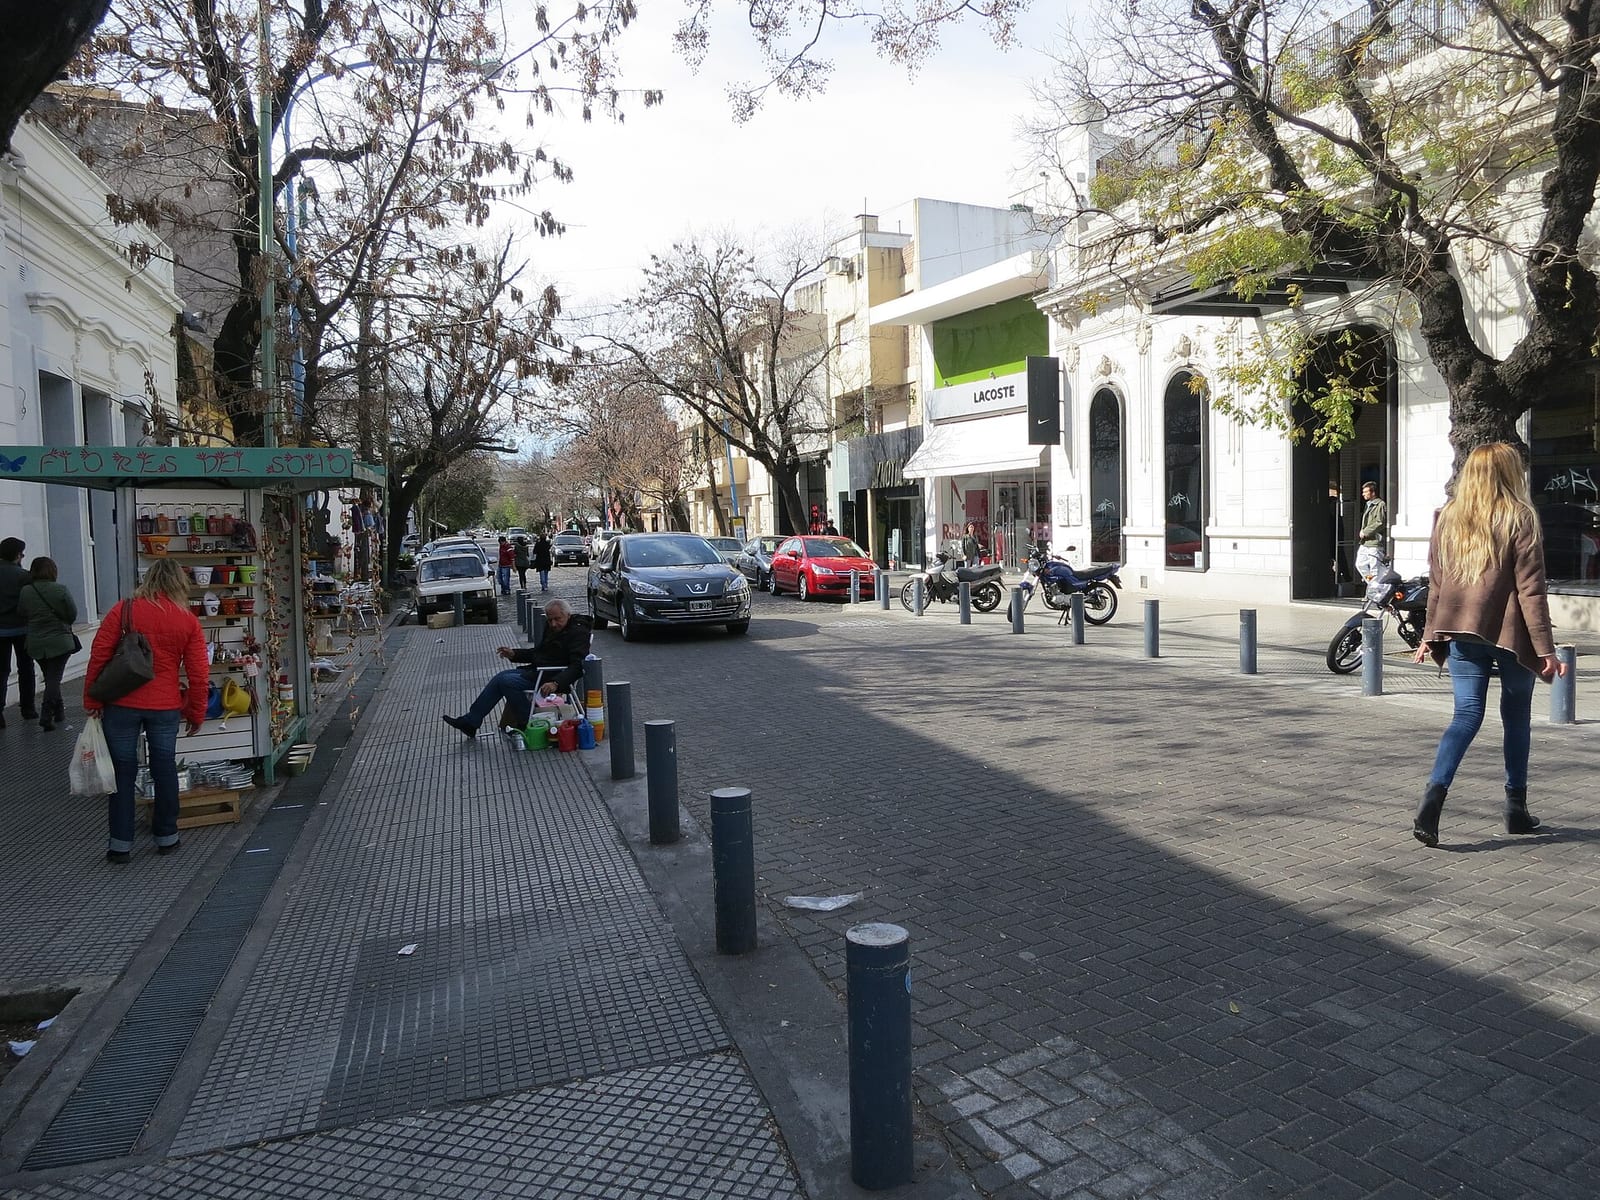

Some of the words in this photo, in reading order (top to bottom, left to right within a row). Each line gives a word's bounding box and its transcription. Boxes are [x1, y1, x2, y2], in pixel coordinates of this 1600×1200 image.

[973, 385, 1015, 403] LACOSTE
[40, 448, 177, 473] FLORES
[196, 450, 253, 474] DEL
[265, 452, 347, 475] SOHO
